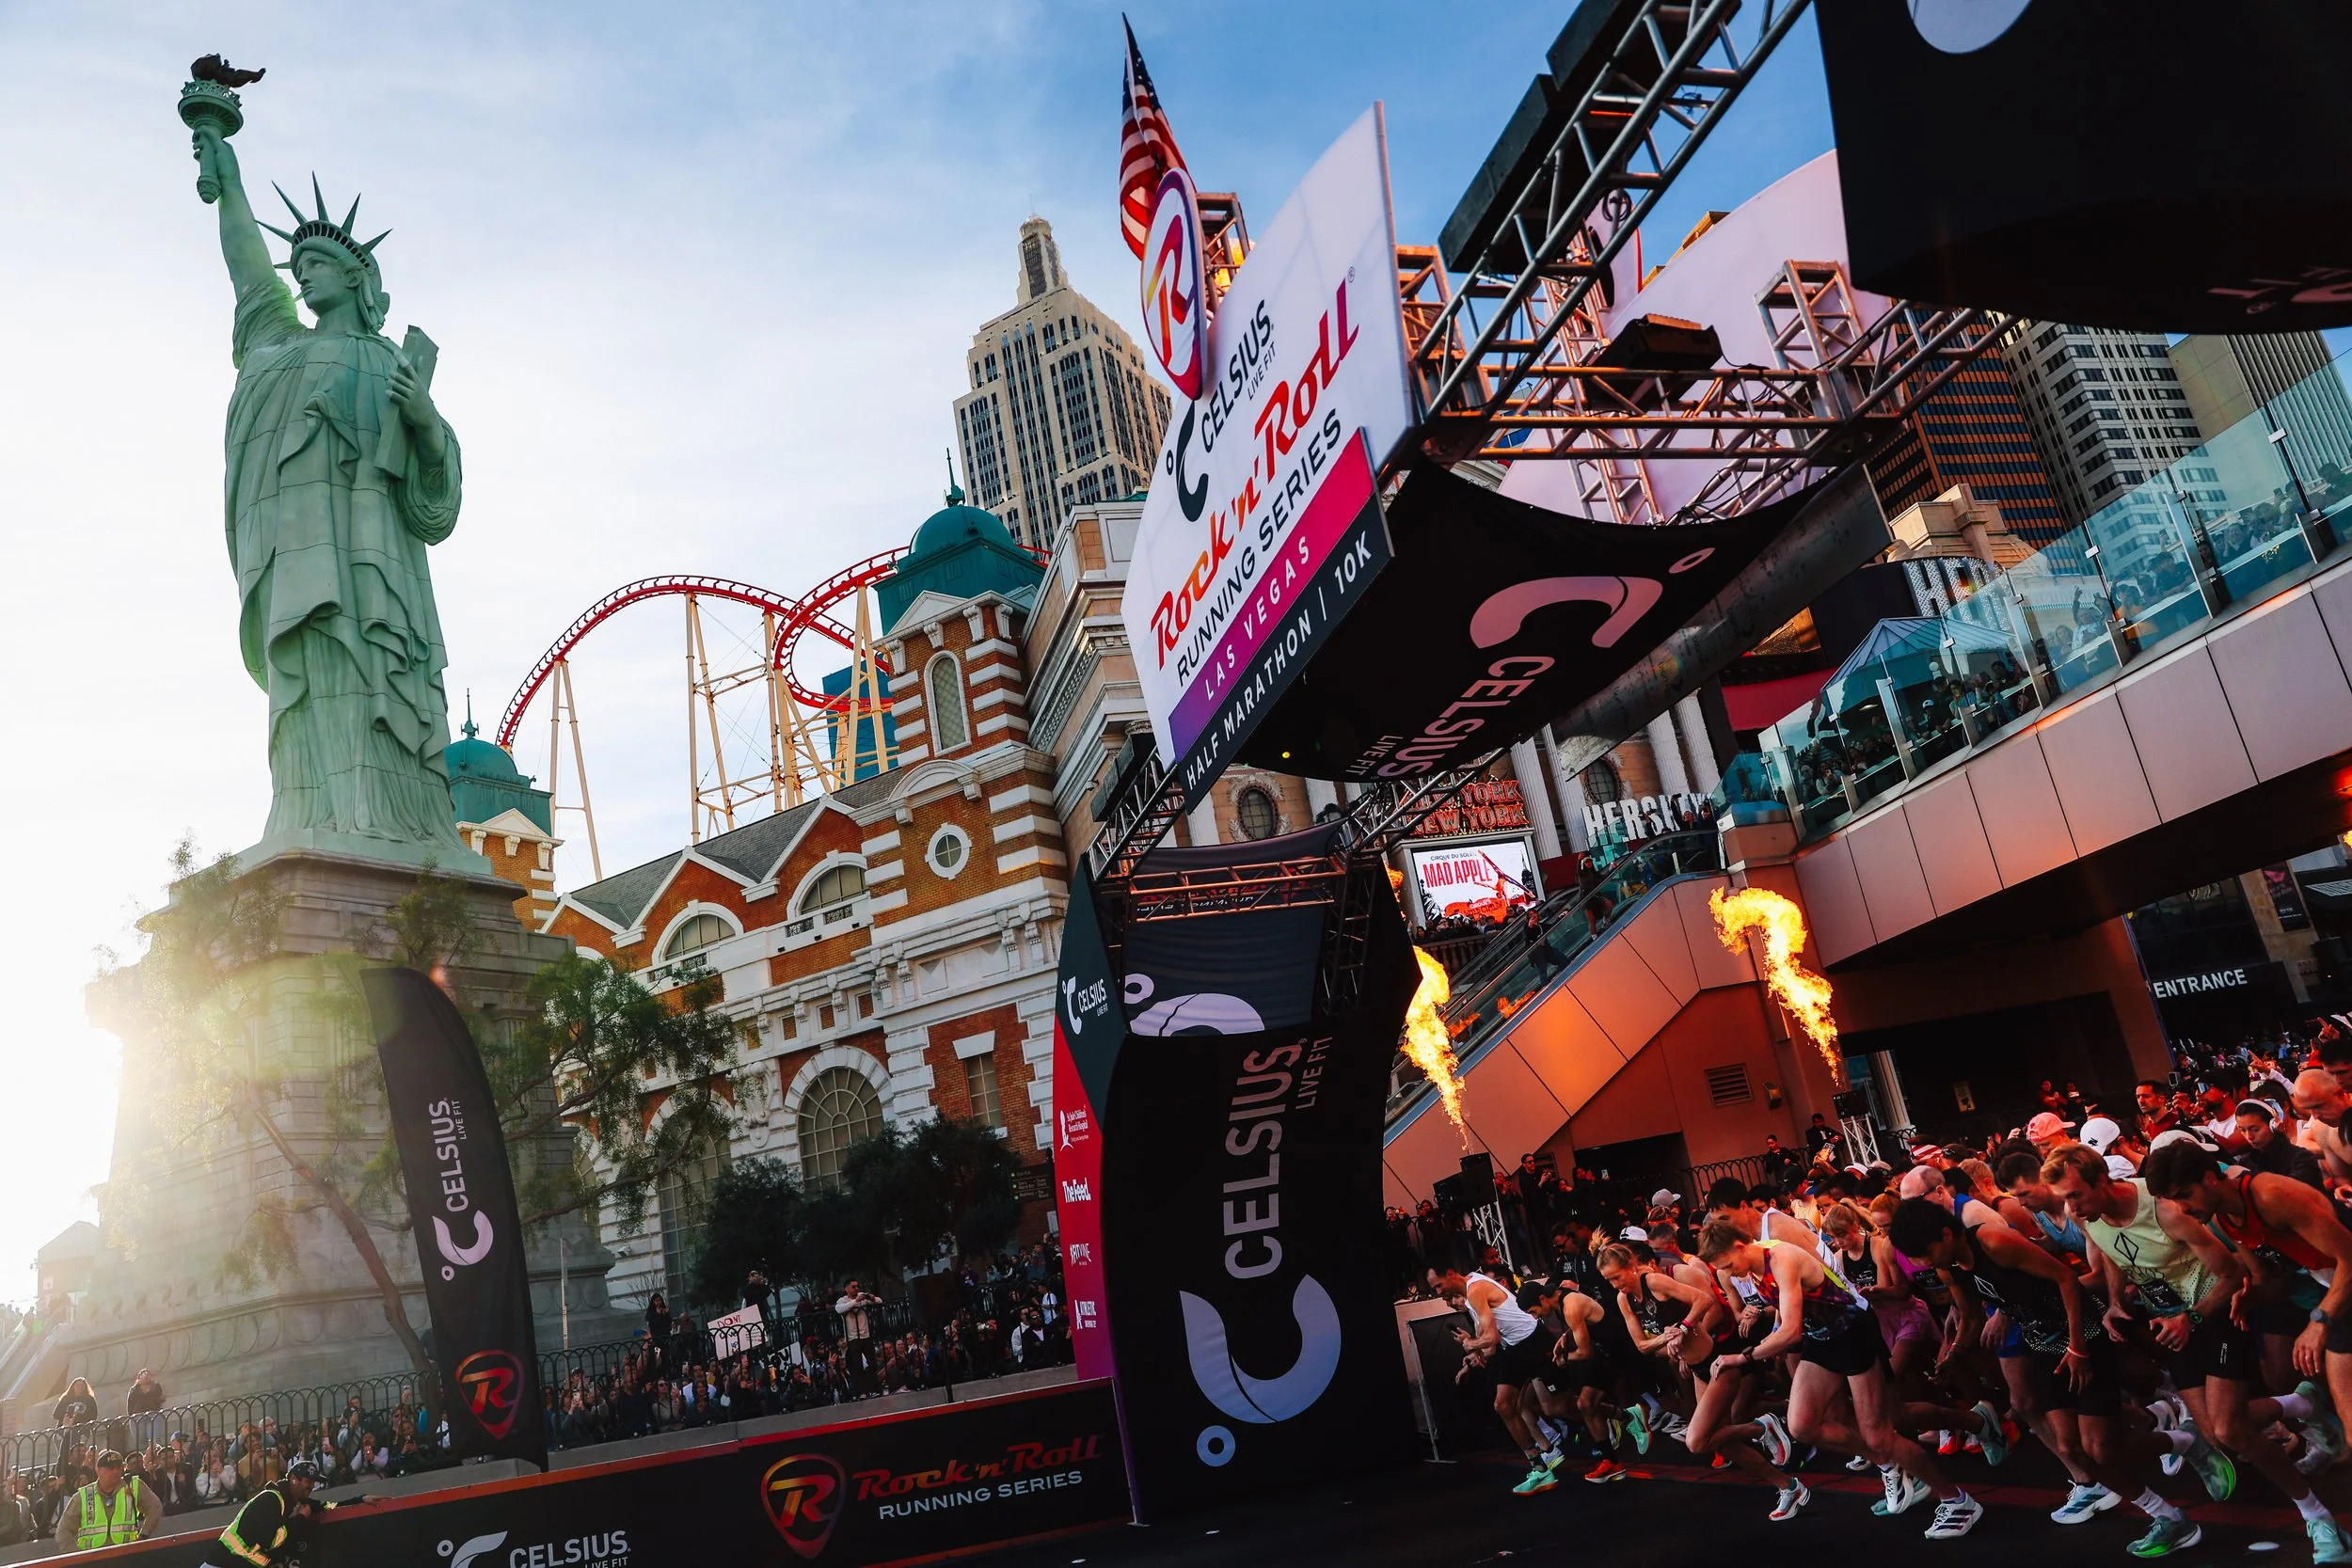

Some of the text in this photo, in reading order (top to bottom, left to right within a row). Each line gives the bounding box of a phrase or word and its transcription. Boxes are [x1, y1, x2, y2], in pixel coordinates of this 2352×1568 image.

[1201, 299, 1271, 452] CELSIUS
[1248, 341, 1276, 401] LIVE FIT
[1176, 408, 1341, 688] RUNNING SERIES
[1205, 536, 1310, 701] LAS VEGAS
[1186, 732, 1219, 790] HALF
[1224, 610, 1311, 741] MARATHON
[1335, 531, 1372, 594] 10K
[1376, 656, 1555, 777] CELSIUS
[1345, 735, 1404, 776] LIVE FIT
[1462, 802, 1530, 830] YORK
[1422, 858, 1493, 889] MAD APPLE
[1078, 978, 1106, 1013] CELSIUS
[2153, 969, 2248, 999] ENTRANCE
[1295, 1036, 1333, 1111] LIVE FIT
[452, 1099, 467, 1141] LIVE FIT
[428, 1099, 469, 1212] CELSIUS
[1224, 1043, 1301, 1279] CELSIUS
[879, 1470, 1082, 1520] RUNNING SERIES
[509, 1530, 628, 1568] CELSIUS
[612, 1557, 628, 1568] FIT
